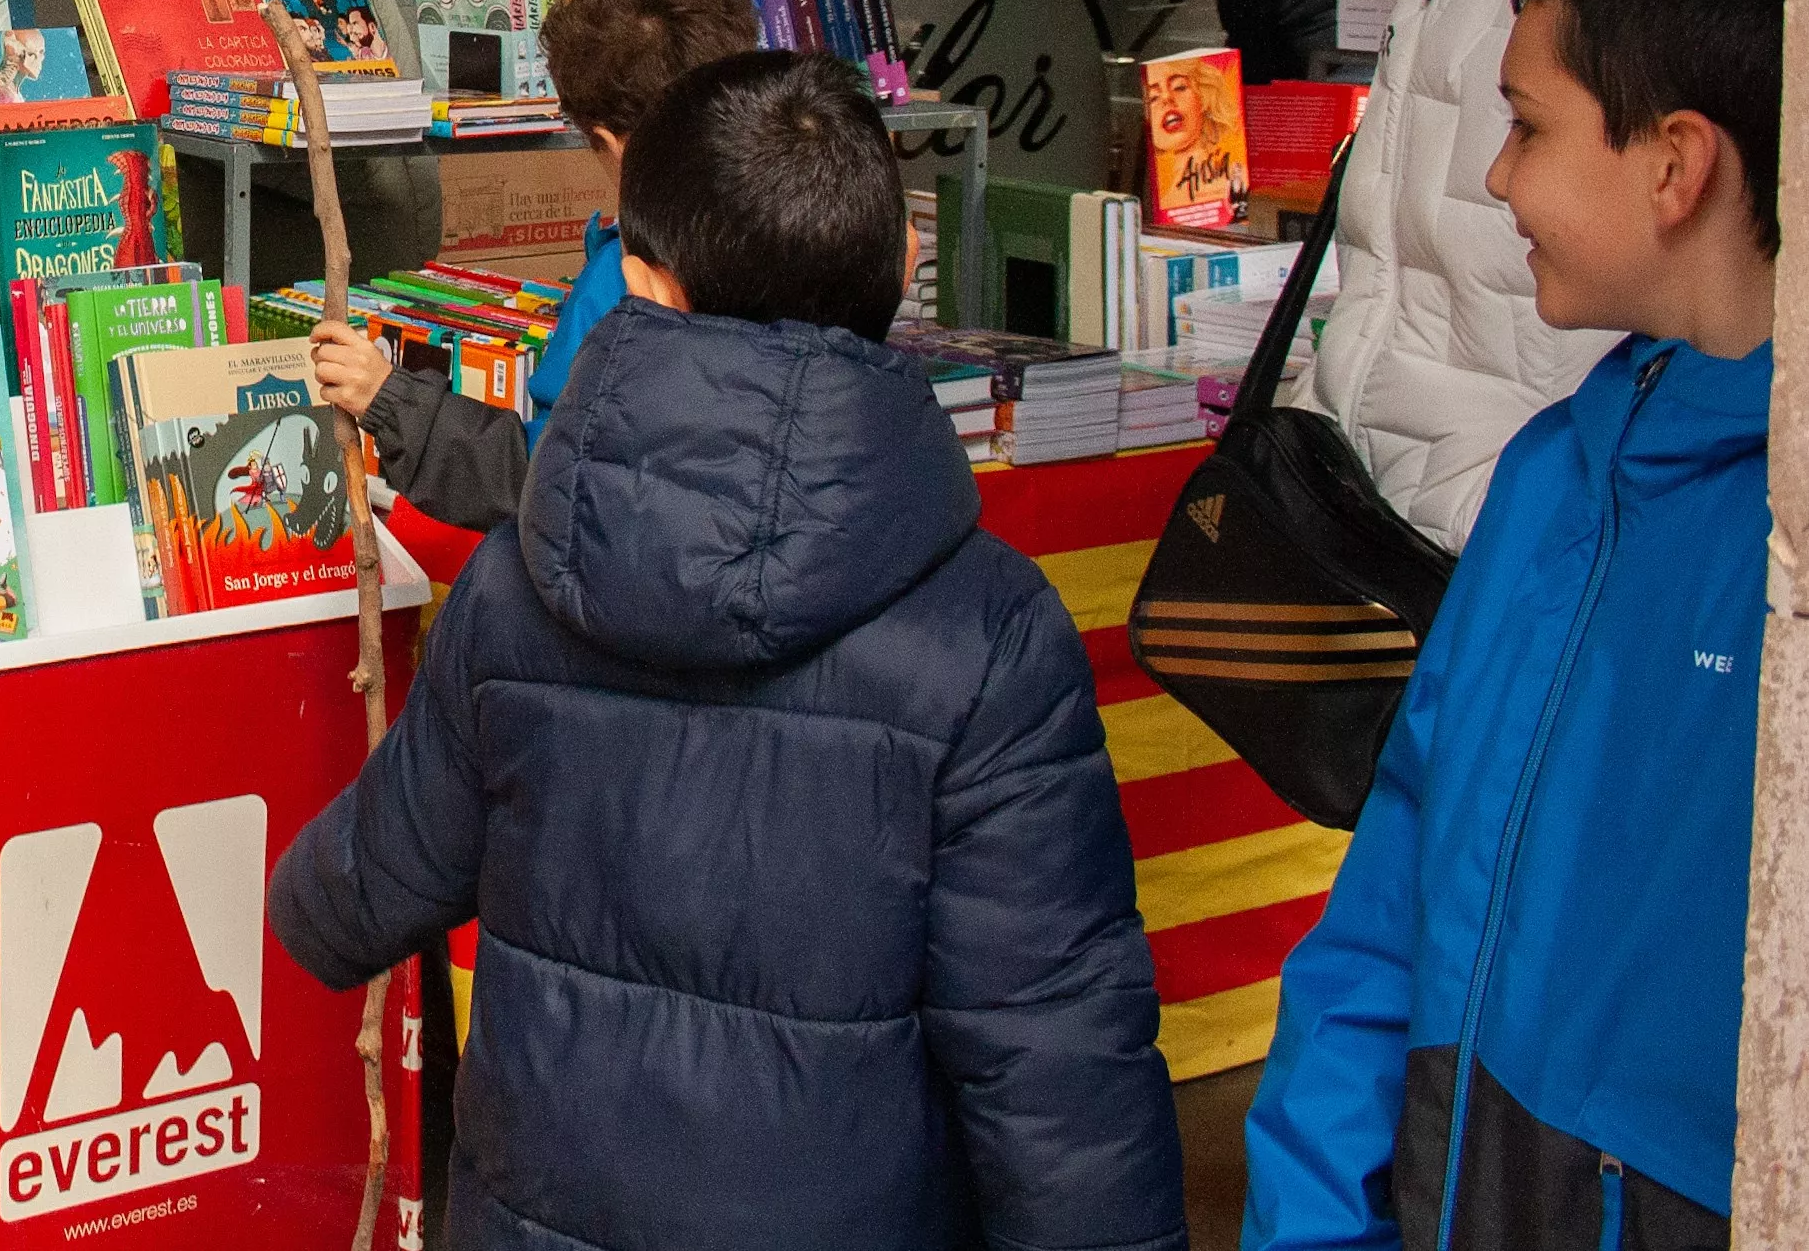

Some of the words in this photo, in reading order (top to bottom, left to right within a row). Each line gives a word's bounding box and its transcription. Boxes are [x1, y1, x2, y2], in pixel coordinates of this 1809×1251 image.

[198, 36, 215, 50] LA
[219, 35, 269, 50] CARTICA
[20, 166, 110, 215] FANTÁSTICA
[509, 193, 534, 208] Hay
[509, 208, 541, 222] cerca
[545, 205, 561, 219] de
[13, 212, 117, 242] ENCICLOPEDIA
[16, 243, 117, 281] DRAGONES
[126, 295, 178, 319] TIERRA
[117, 324, 130, 338] EL
[130, 317, 187, 337] UNIVERSO
[228, 360, 239, 369] EL
[245, 390, 302, 412] LIBRO
[224, 575, 251, 592] San
[253, 572, 289, 591] Jorge
[291, 570, 299, 586] y
[303, 565, 316, 582] el
[318, 560, 356, 580] dragó
[7, 1094, 250, 1205] everest
[63, 1192, 199, 1243] www.everest.es
